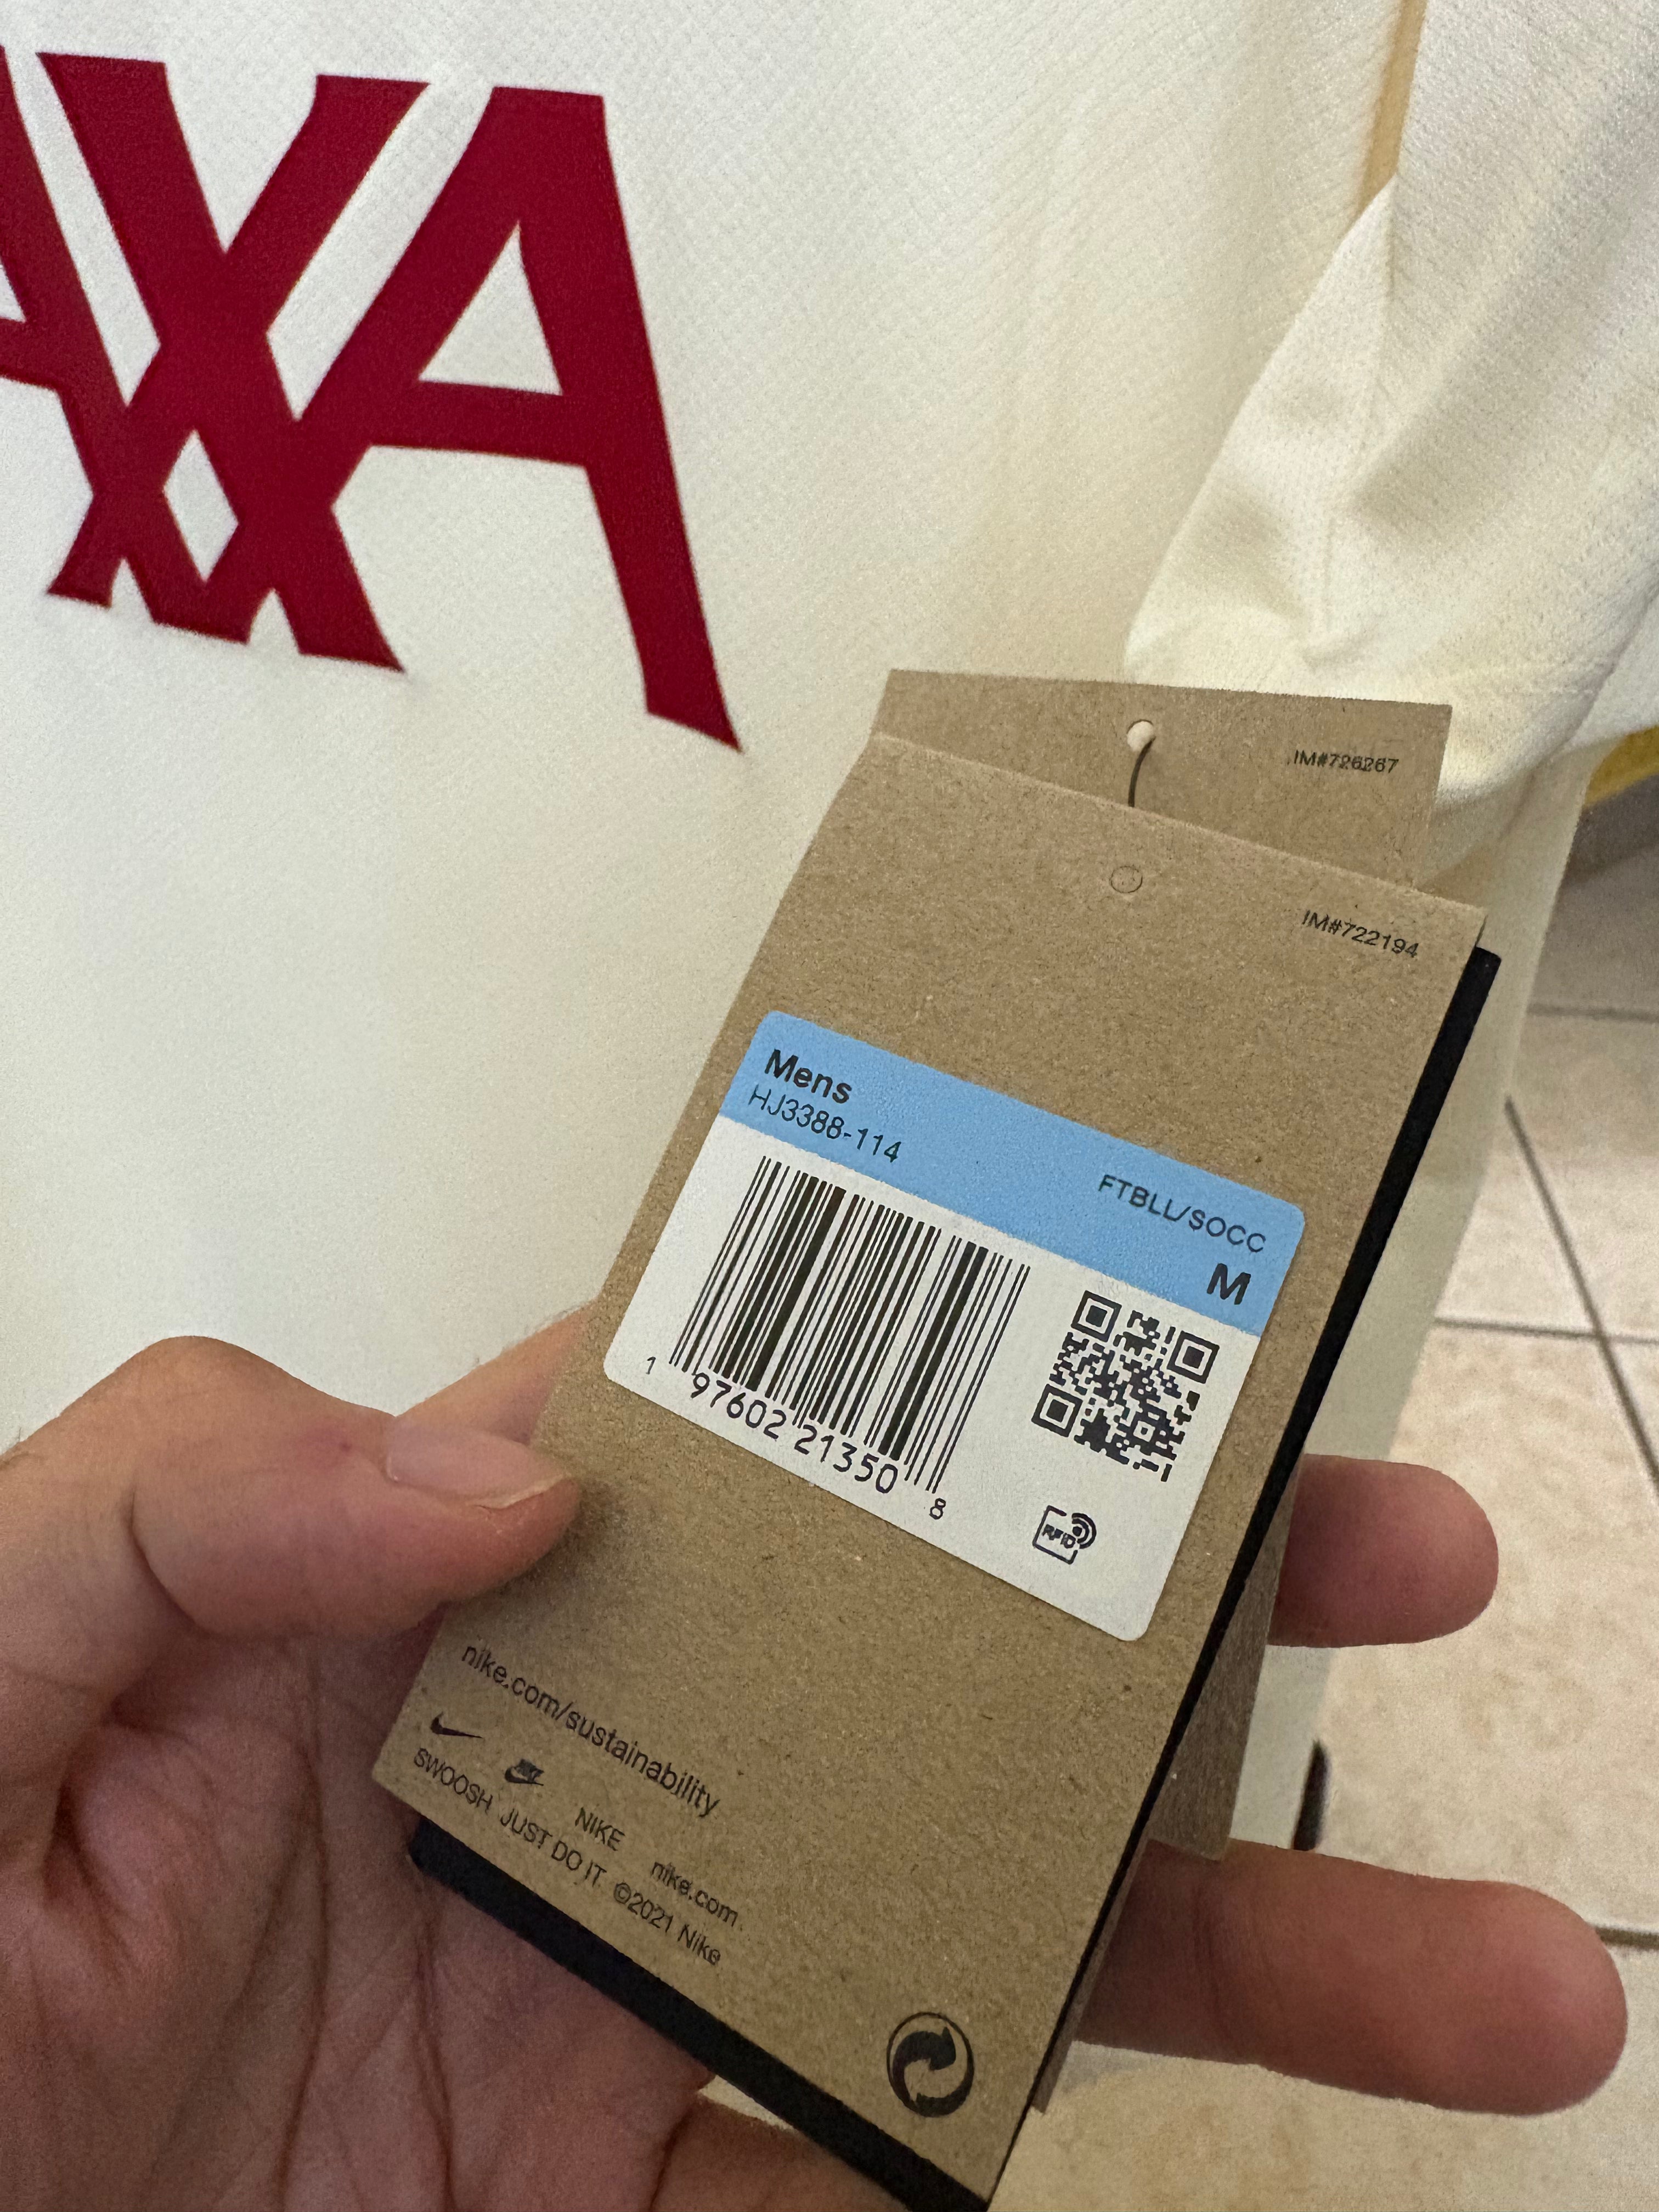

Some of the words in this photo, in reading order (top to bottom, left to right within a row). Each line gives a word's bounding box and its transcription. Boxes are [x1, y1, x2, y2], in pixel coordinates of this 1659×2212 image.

[1301, 910, 1420, 958] IM#722194
[764, 1048, 853, 1104] Mens
[748, 1084, 903, 1163] HJ3388-114
[1098, 1174, 1266, 1253] FTBLL/SOCC
[1206, 1262, 1252, 1305] M
[646, 1356, 657, 1375] 1
[690, 1373, 787, 1441] 97602
[794, 1425, 898, 1494] 21350
[929, 1497, 946, 1520] 8
[461, 1645, 721, 1818] nike.com/sustainability
[414, 1747, 494, 1815] SWOOSH
[500, 1808, 553, 1849] JUST
[551, 1839, 584, 1871] DO
[585, 1861, 607, 1887] IT
[612, 1882, 674, 1933] ©2021
[678, 1924, 721, 1966] Nike
[574, 1807, 625, 1852] NIKE
[650, 1861, 739, 1927] nike.com
